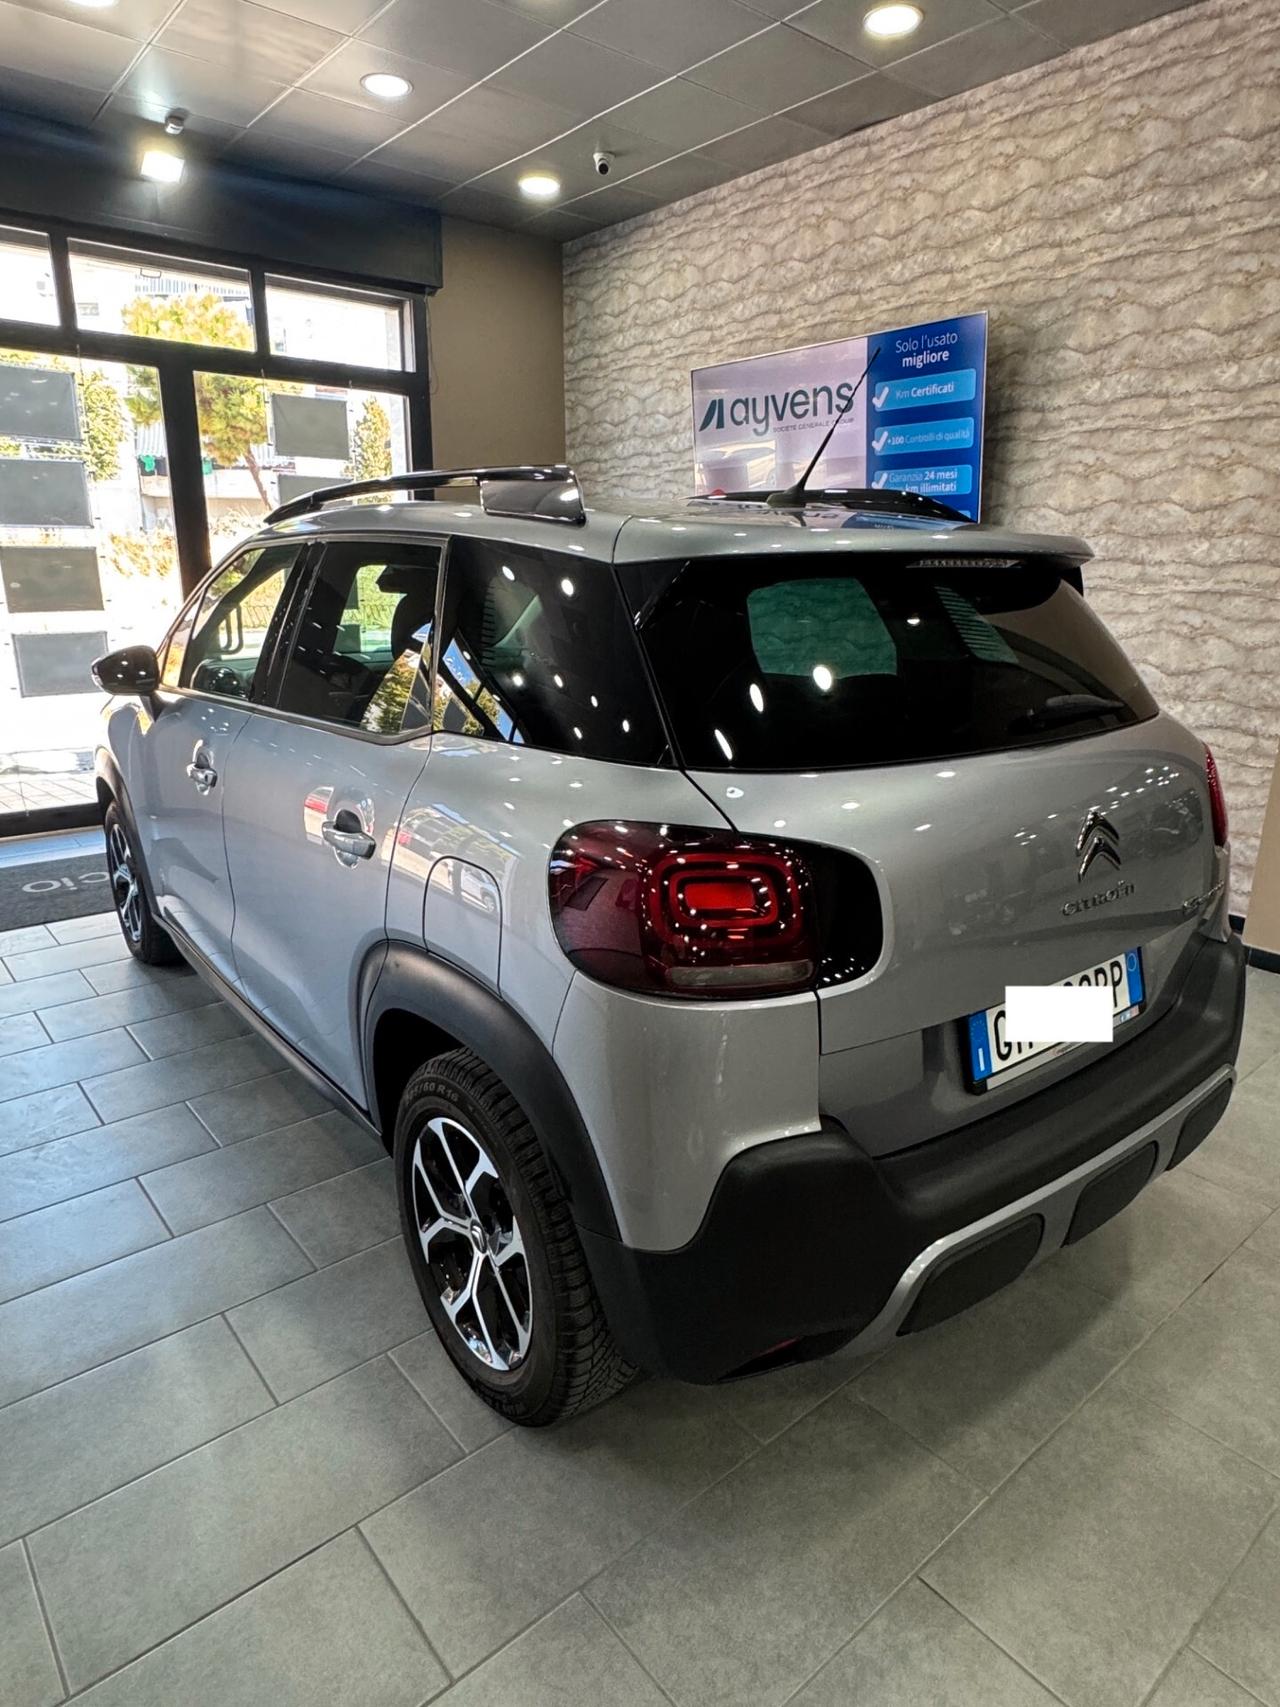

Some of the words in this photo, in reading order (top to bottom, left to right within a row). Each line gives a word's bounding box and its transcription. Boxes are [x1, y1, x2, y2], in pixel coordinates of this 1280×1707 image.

[895, 337, 918, 354] Solo
[921, 332, 958, 350] l'usato
[902, 350, 950, 368] migliore
[911, 381, 955, 398] Certificati
[730, 382, 854, 436] ayvens
[924, 471, 935, 481] 24
[936, 468, 958, 479] mesi
[905, 483, 919, 493] km
[920, 481, 957, 493] illimitati
